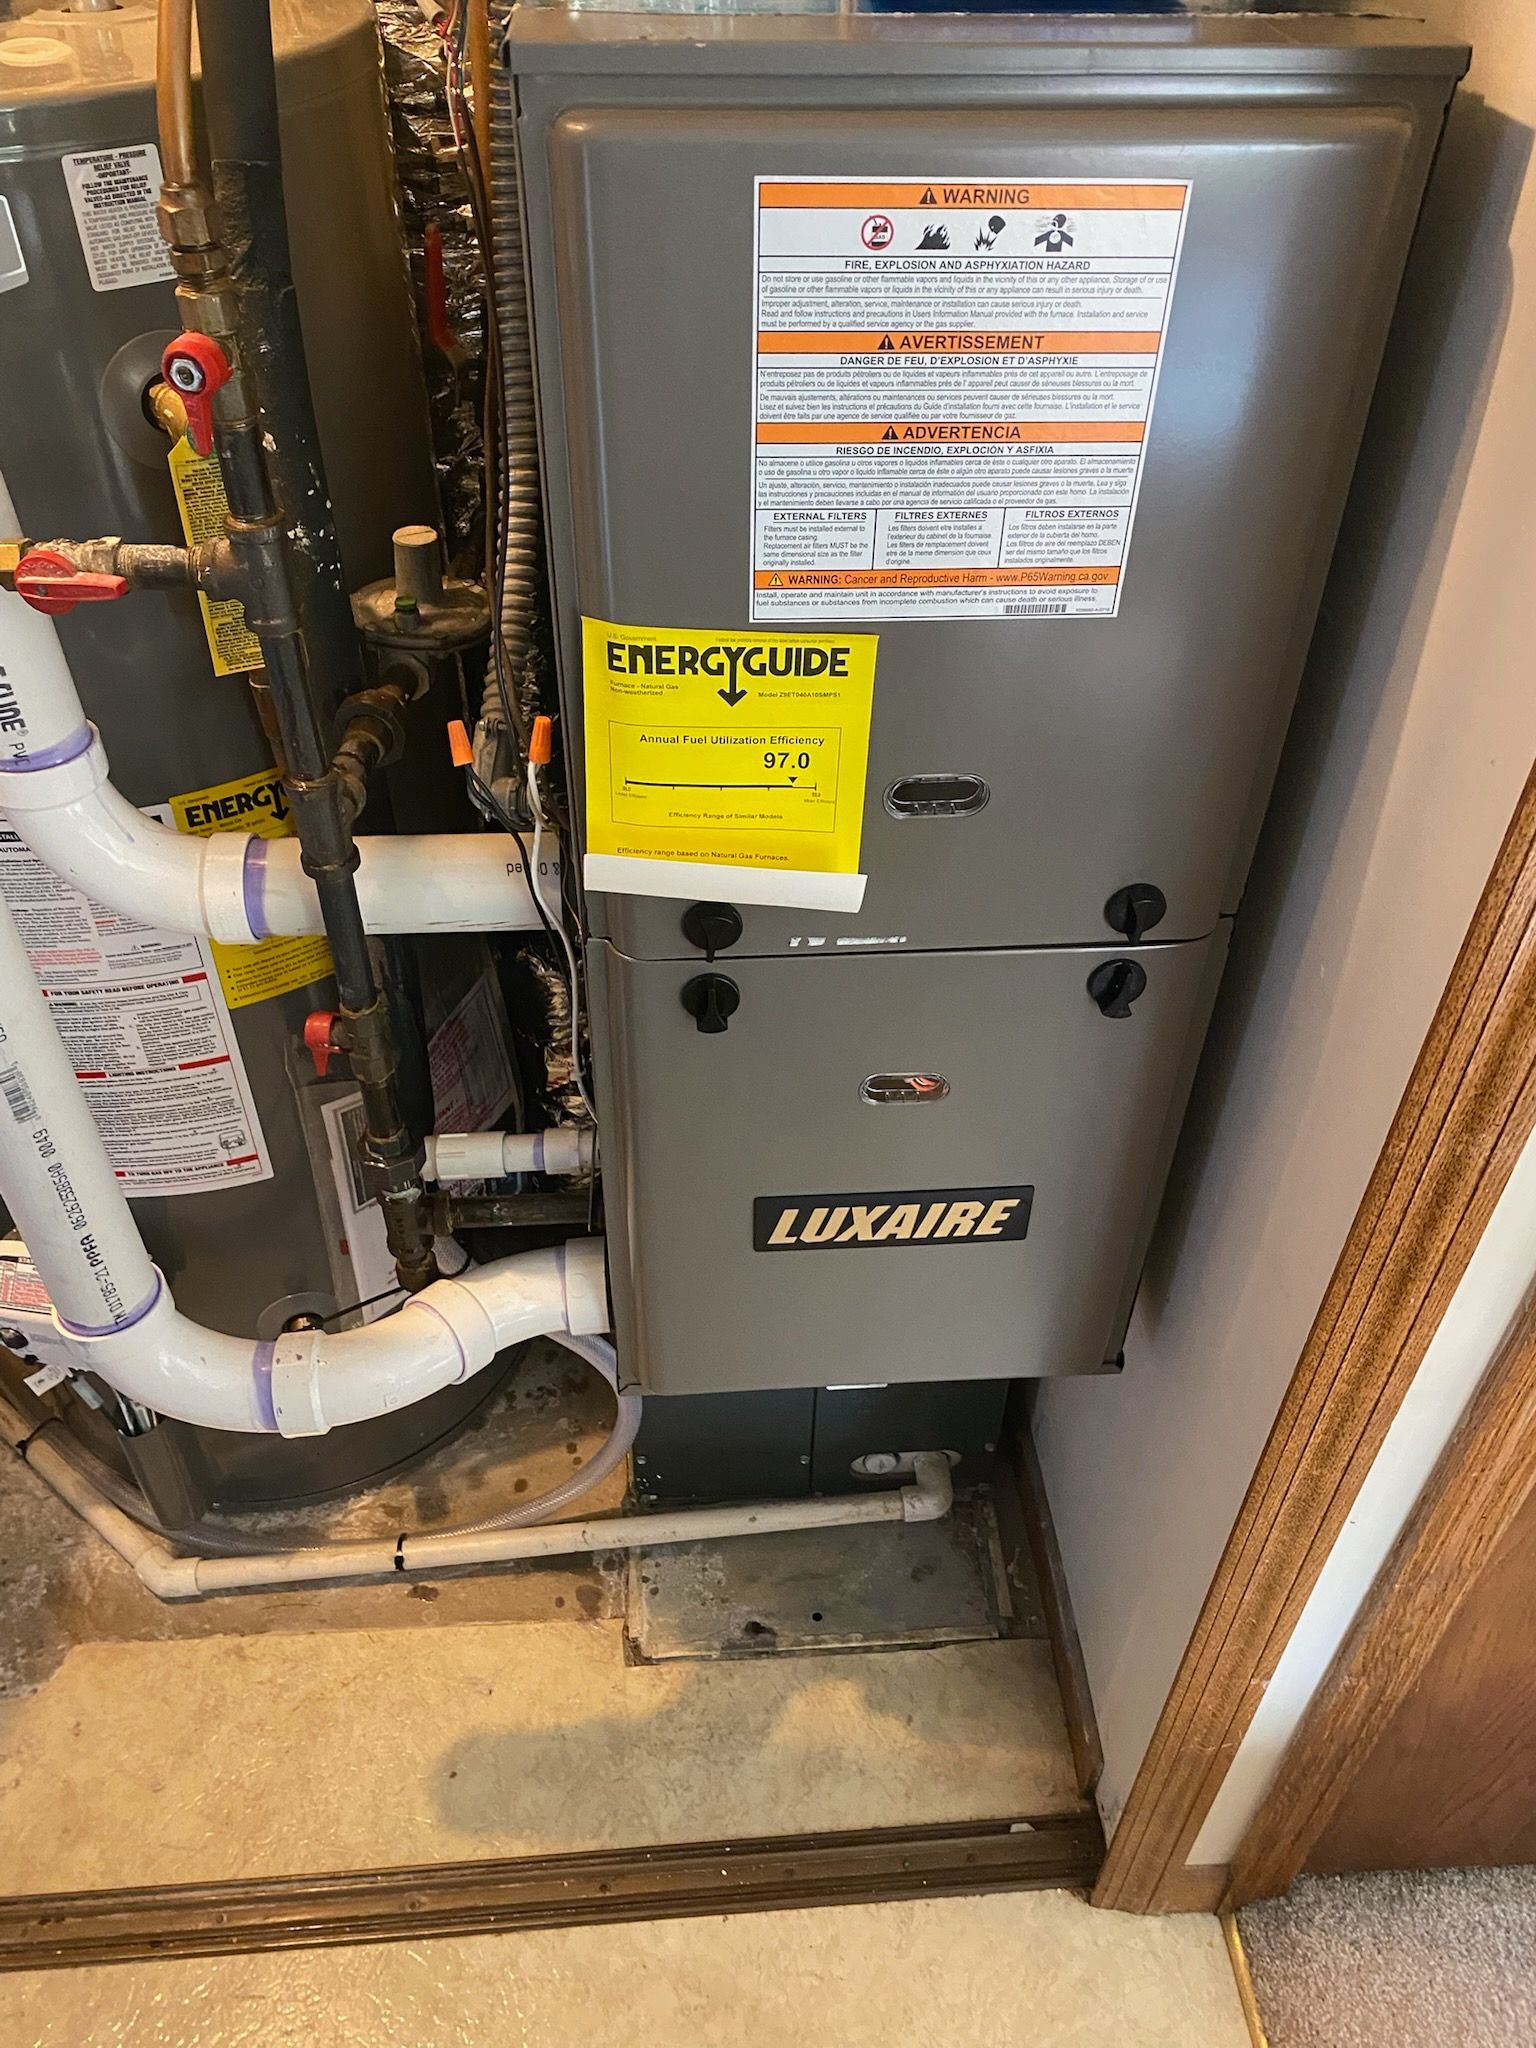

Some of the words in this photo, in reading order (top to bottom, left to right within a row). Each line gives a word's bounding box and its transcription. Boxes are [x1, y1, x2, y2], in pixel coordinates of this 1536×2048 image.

[943, 189, 1030, 204] WARNING
[845, 260, 871, 271] FIRE,
[874, 260, 936, 271] EXPLOSION
[938, 260, 962, 271] AND
[964, 260, 1043, 271] ASPHYXIATION
[1046, 260, 1090, 271] HAZARD
[772, 275, 783, 283] not
[784, 275, 801, 283] store
[824, 275, 852, 285] gasoline
[861, 275, 879, 283] other
[880, 275, 914, 283] flammable
[916, 277, 937, 285] vapors
[939, 275, 952, 283] and
[952, 275, 974, 285] liquids
[975, 275, 981, 283] in
[982, 275, 993, 283] the
[994, 275, 1016, 285] vicinity
[1017, 275, 1024, 283] of
[1025, 275, 1037, 283] this
[1047, 277, 1059, 285] any
[1060, 276, 1077, 284] other
[1112, 276, 1138, 286] Storage
[1139, 276, 1146, 284] of
[900, 335, 1044, 350] AVERTISSEMENT
[840, 355, 884, 366] DANGER
[887, 355, 901, 366] DE
[903, 355, 929, 366] FEU,
[930, 355, 999, 366] D'EXPLOSION
[1002, 355, 1014, 366] ET
[1017, 354, 1078, 366] D'ASPHYXIE
[903, 426, 1021, 440] ADVERTENCIA
[836, 446, 874, 456] RIESGO
[876, 445, 890, 456] DE
[892, 445, 943, 456] INCENDIO,
[1007, 445, 1013, 455] Y
[1015, 444, 1054, 455] ASFIXIA
[773, 512, 824, 521] EXTERNAL
[827, 512, 867, 520] FILTERS
[895, 511, 933, 520] FILTRES
[936, 510, 987, 520] EXTERNES
[1025, 510, 1065, 519] FILTROS
[1067, 509, 1119, 519] EXTERNOS
[788, 573, 841, 584] WARNING:
[844, 573, 876, 584] Cancer
[880, 572, 897, 584] and
[897, 572, 959, 586] Reproductive
[962, 572, 987, 583] Harm
[993, 571, 1109, 585] www.P65Warning.ca.gov
[780, 590, 807, 600] operate
[808, 590, 822, 598] and
[823, 589, 854, 598] maintain
[855, 589, 868, 597] unit
[869, 589, 876, 597] in
[877, 589, 918, 597] accordance
[919, 588, 934, 596] with
[988, 588, 1027, 596] instructions
[1028, 588, 1036, 596] to
[1037, 587, 1056, 595] avoid
[1057, 589, 1089, 597] exposure
[878, 597, 916, 606] incomplete
[918, 596, 958, 604] combustion
[1017, 595, 1037, 603] death
[619, 633, 657, 642] Government
[607, 641, 850, 677] ENERGYGUIDE
[610, 688, 663, 696] Non-weatherized
[639, 735, 679, 744] Annual
[682, 735, 706, 744] Fuel
[710, 735, 766, 744] Utilization
[769, 735, 825, 746] Efficiency
[763, 752, 810, 769] 97.0
[668, 811, 701, 820] Efficiency
[702, 812, 724, 820] Range
[617, 847, 652, 857] Efficiency
[676, 849, 698, 857] based
[32, 1128, 55, 1158] 0049
[767, 1198, 1021, 1246] LUXAIRE
[79, 1233, 103, 1268] PPFA
